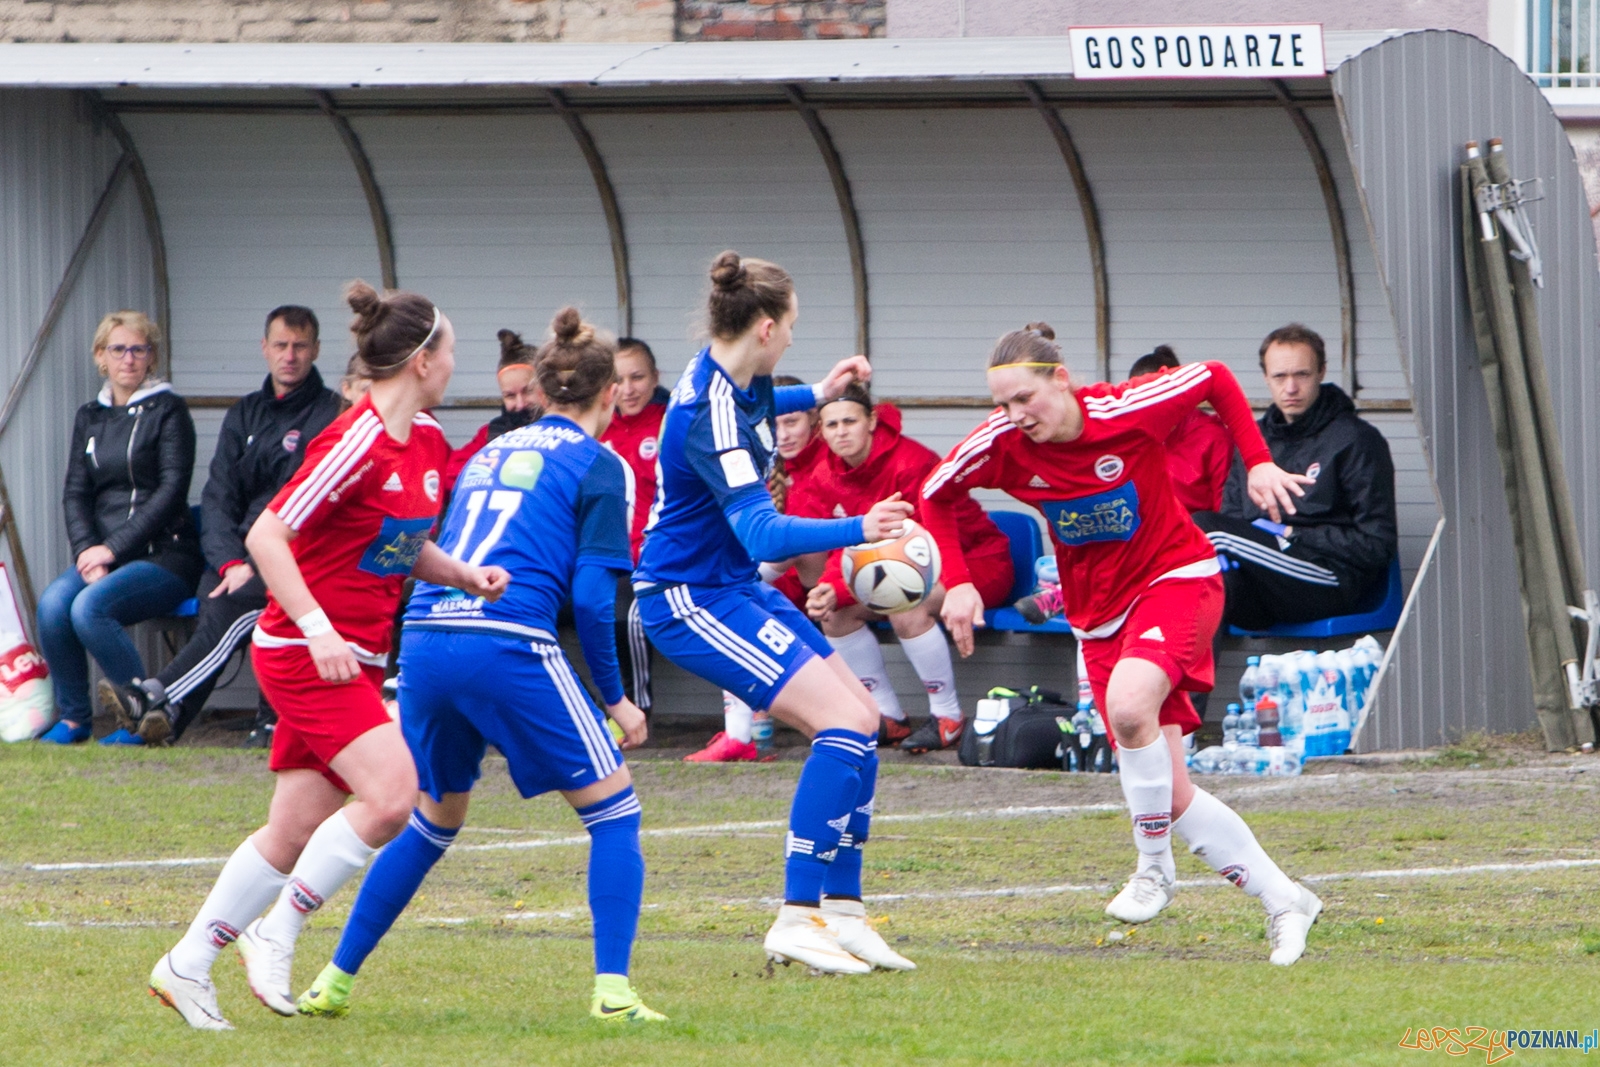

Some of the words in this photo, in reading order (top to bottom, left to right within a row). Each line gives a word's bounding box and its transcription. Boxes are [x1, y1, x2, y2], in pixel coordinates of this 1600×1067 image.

[1085, 34, 1304, 68] GOSPODARZE
[452, 490, 523, 567] 17
[1057, 506, 1134, 529] ASTRA
[756, 618, 796, 655] 80
